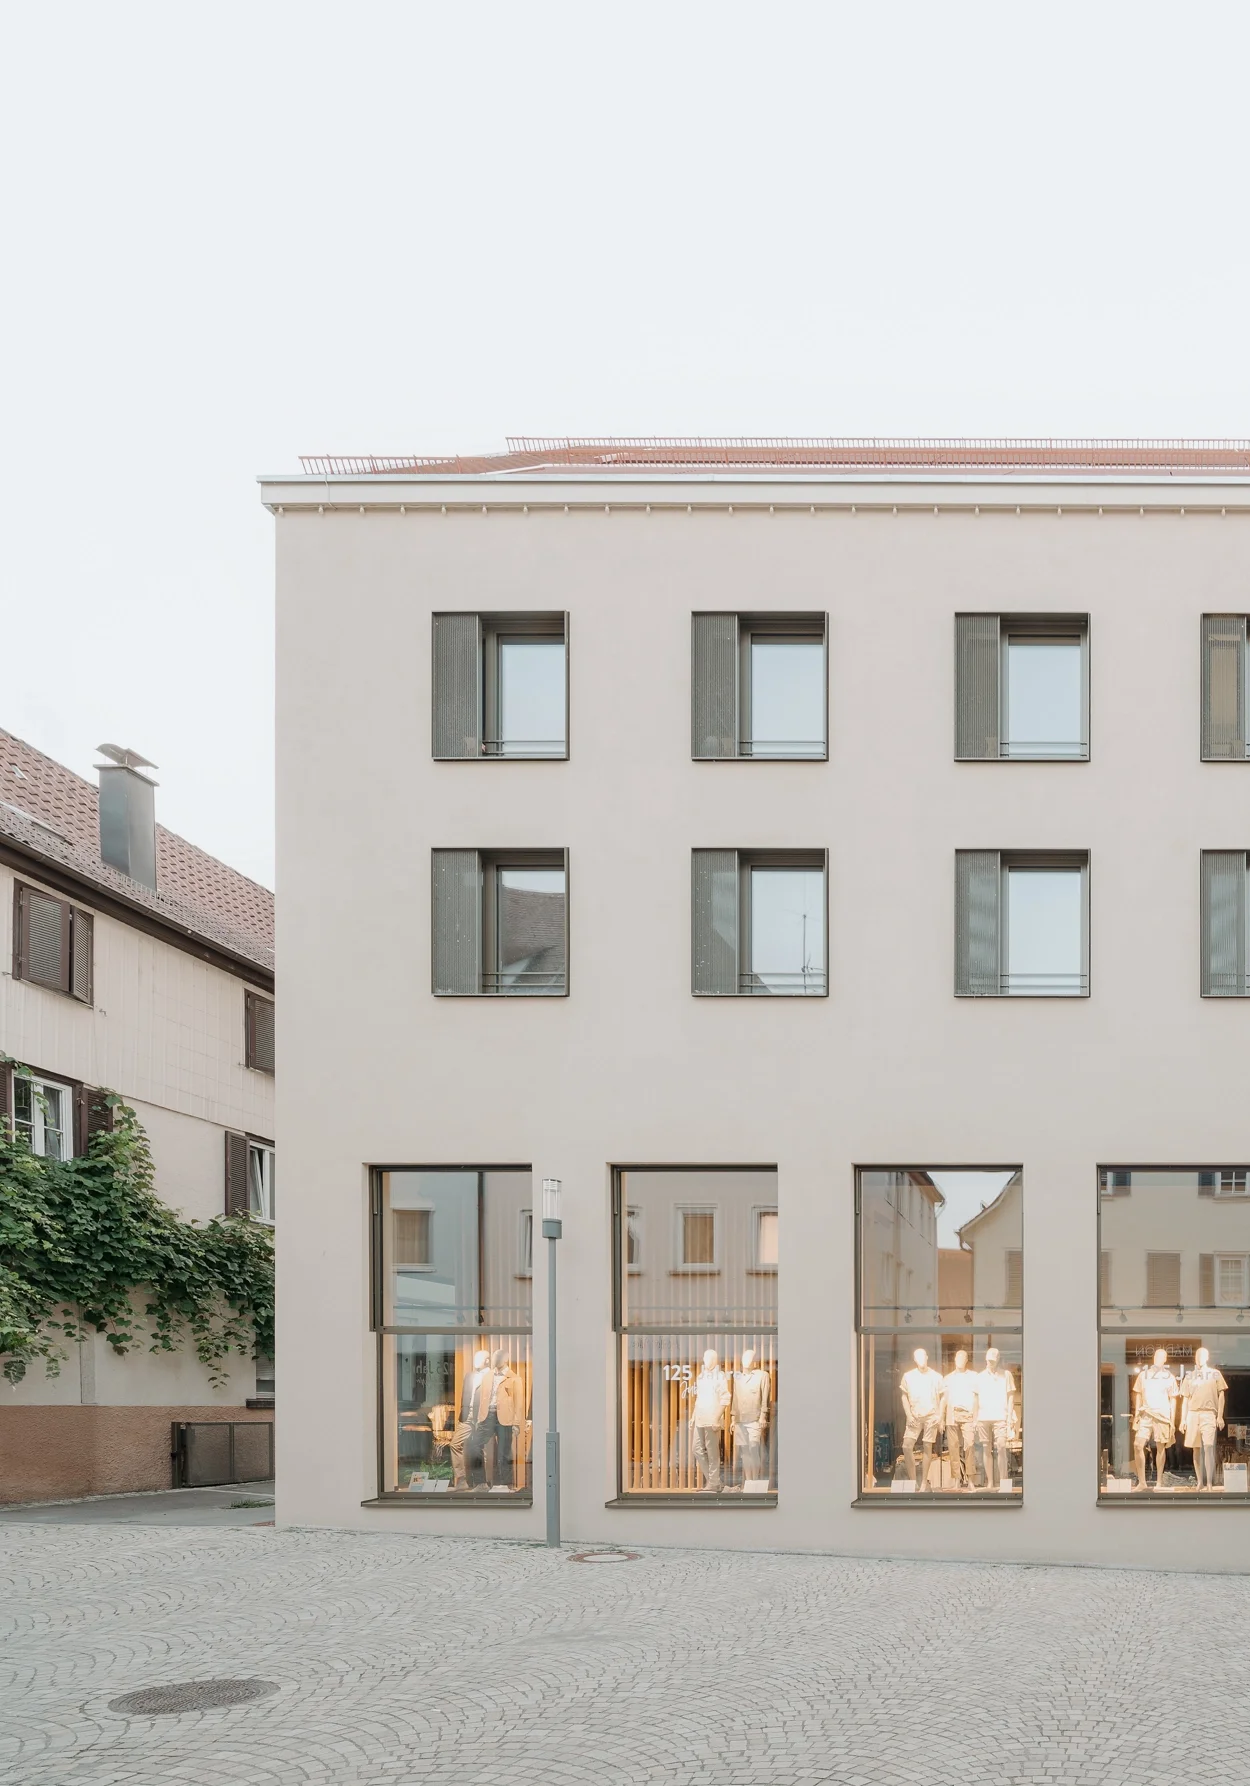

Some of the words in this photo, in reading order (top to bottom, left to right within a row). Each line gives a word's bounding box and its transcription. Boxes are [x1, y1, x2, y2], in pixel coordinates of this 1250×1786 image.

[663, 1364, 692, 1381] 125
[1142, 1364, 1171, 1380] 125
[1176, 1364, 1221, 1381] Jahre
